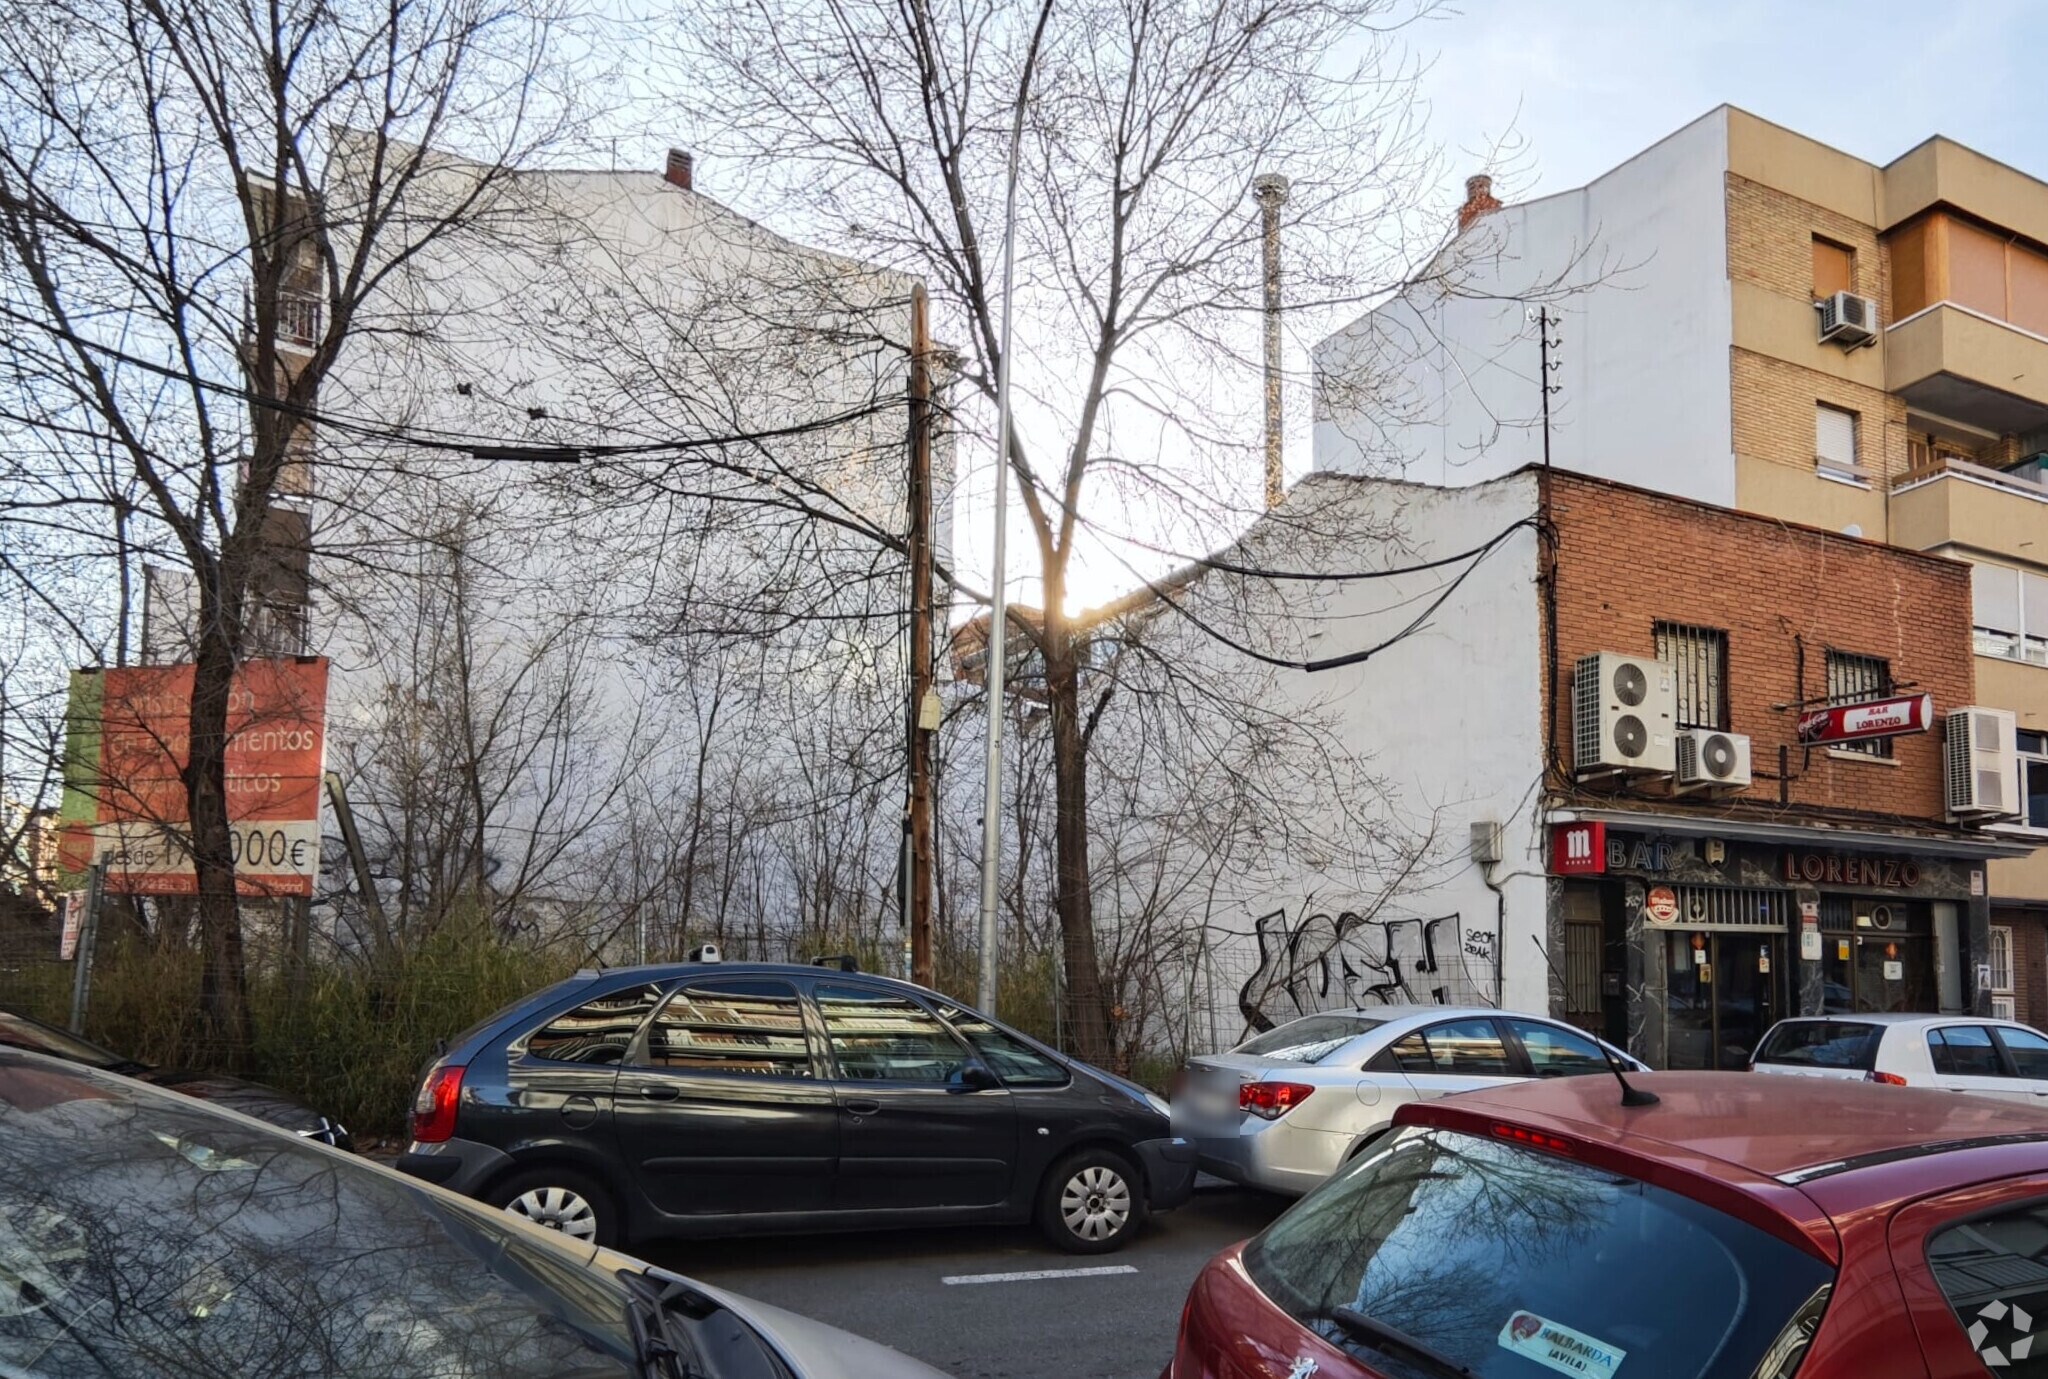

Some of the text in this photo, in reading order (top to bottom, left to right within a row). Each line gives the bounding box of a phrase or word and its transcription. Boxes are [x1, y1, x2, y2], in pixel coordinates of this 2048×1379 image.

[1856, 716, 1902, 730] LORENZO
[1607, 838, 1675, 871] BAR
[1785, 852, 1921, 888] LORENZO
